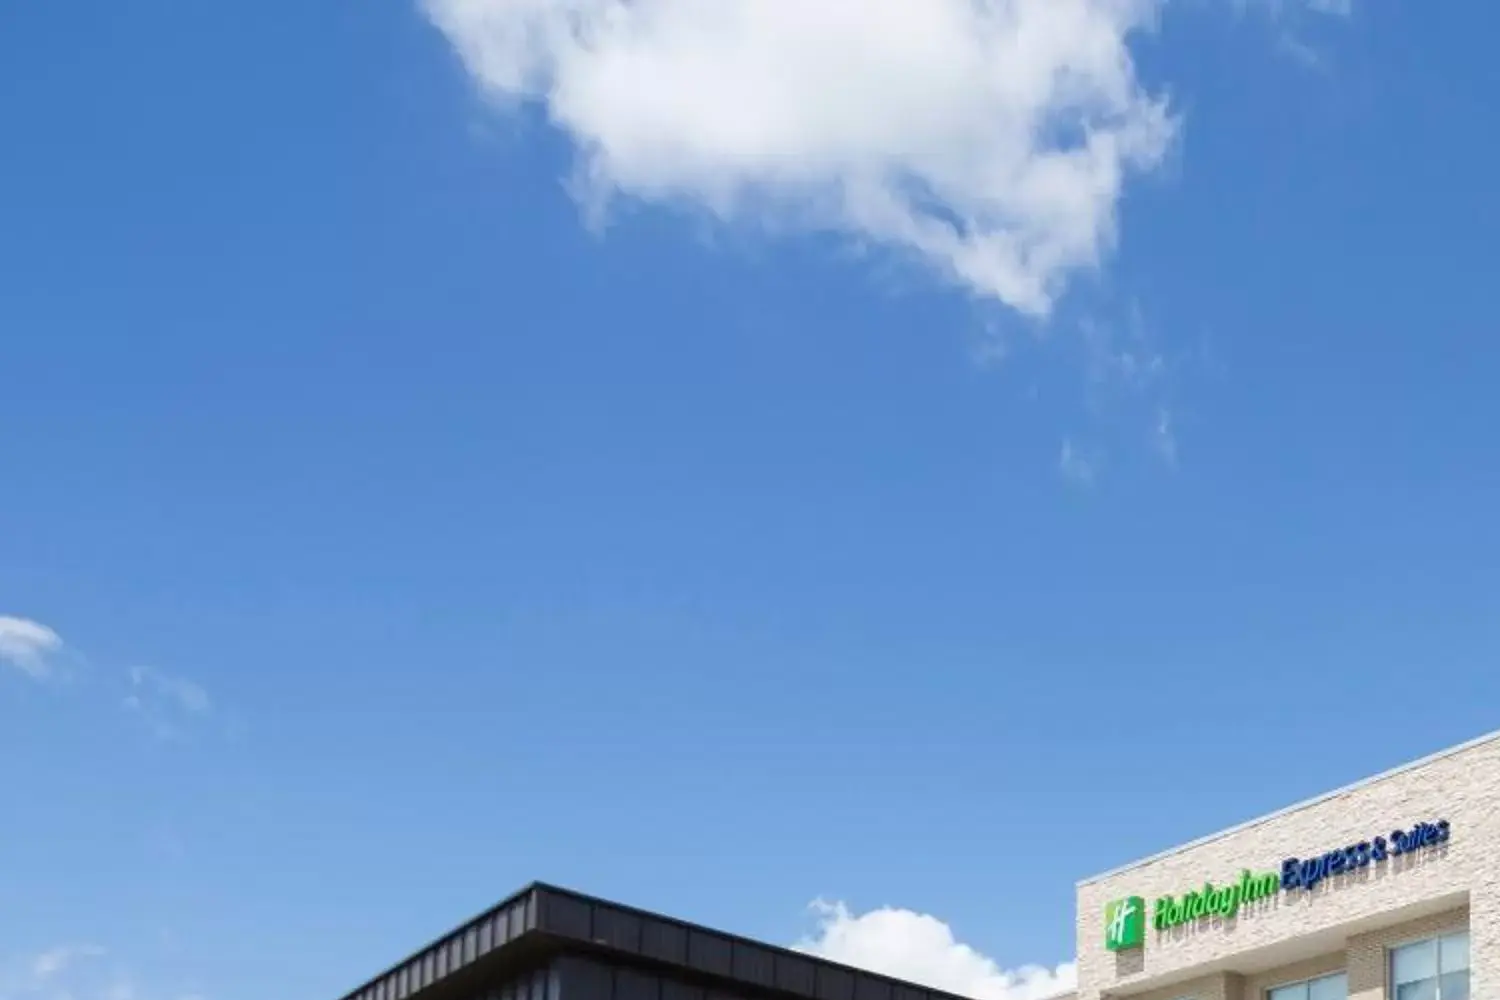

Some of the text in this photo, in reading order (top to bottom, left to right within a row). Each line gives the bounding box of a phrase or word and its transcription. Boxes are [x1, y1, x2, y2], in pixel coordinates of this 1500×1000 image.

[1153, 819, 1450, 929] Holiday Inn Express & Suites
